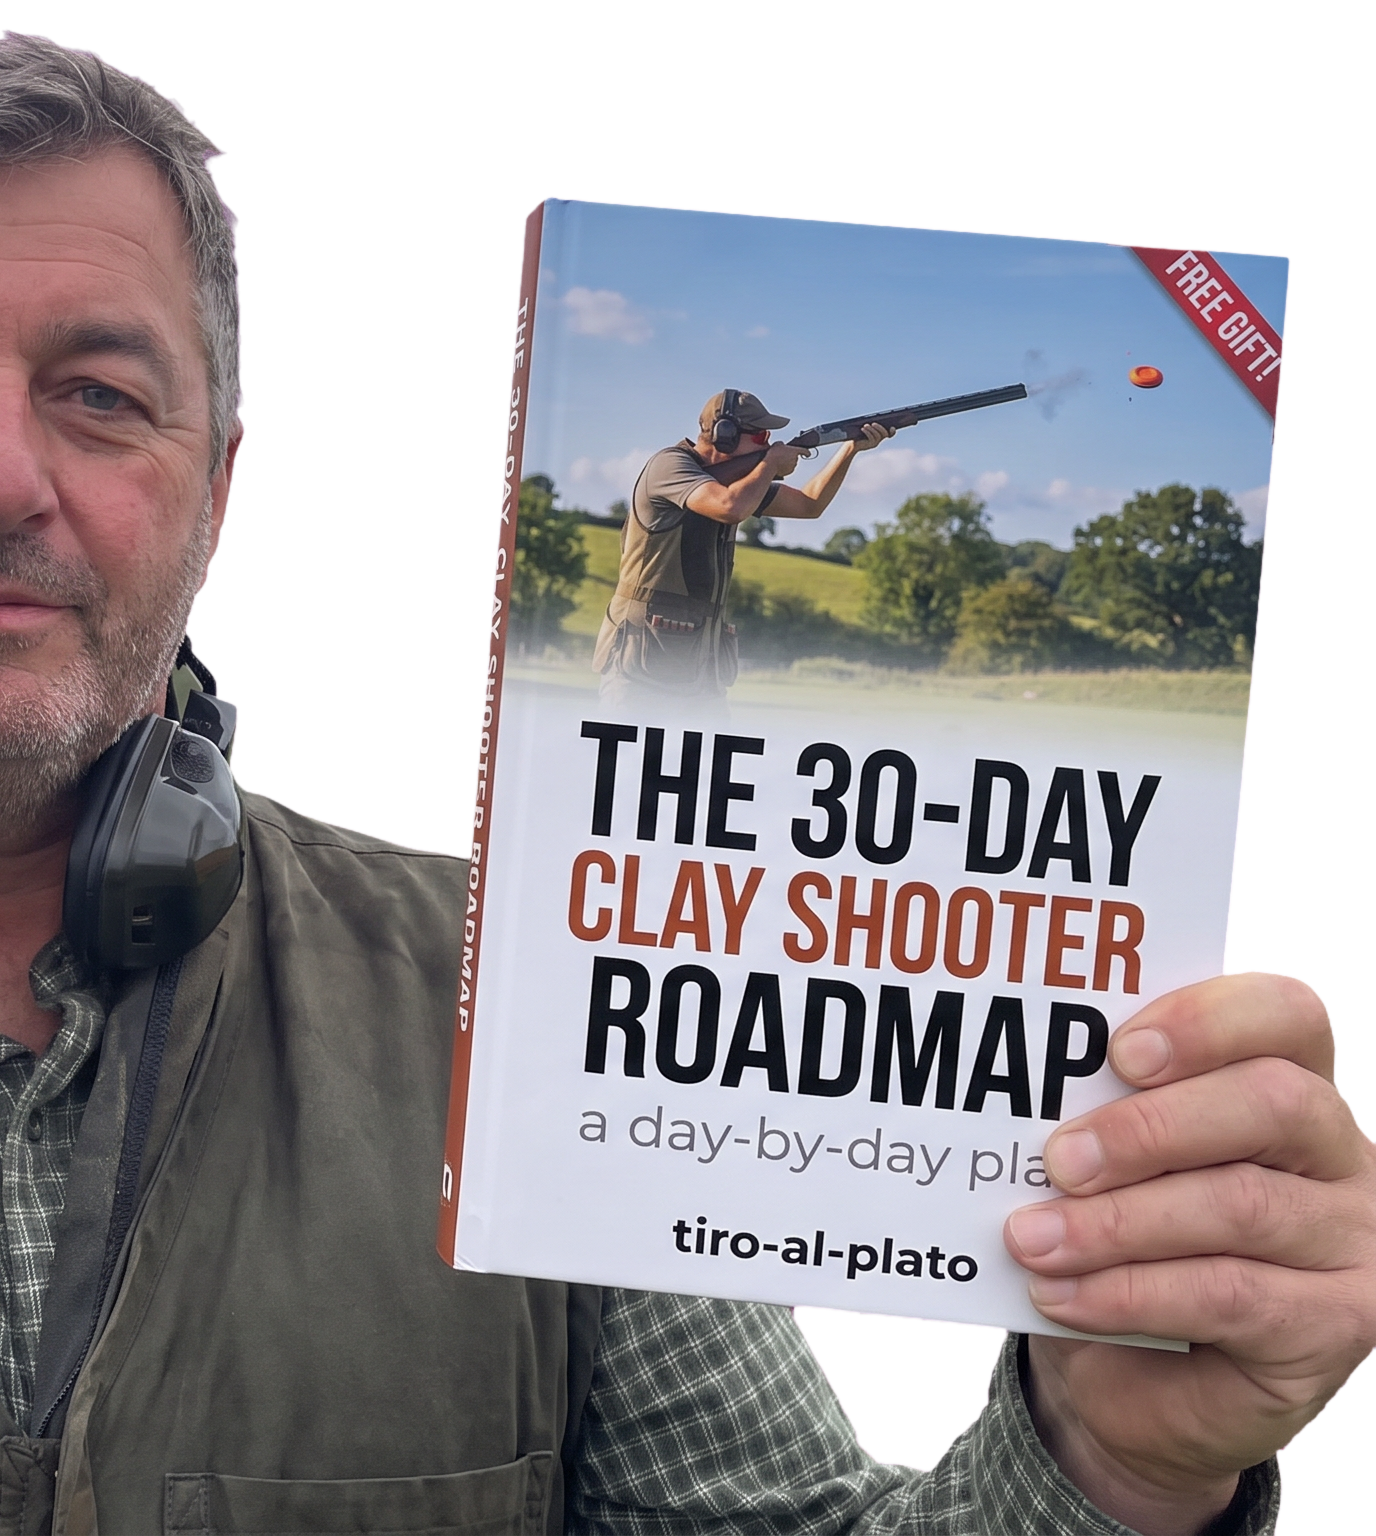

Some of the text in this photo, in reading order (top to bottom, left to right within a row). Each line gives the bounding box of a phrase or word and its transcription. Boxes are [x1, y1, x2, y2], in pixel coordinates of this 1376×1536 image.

[1165, 250, 1283, 383] FREE GIFT!
[459, 297, 528, 1032] THE 30-DAY CLAY SHOOTER ROADMAP
[581, 721, 1161, 886] THE 30-DAY
[568, 849, 1145, 994] CLAY SHOOTER
[585, 956, 1108, 1121] ROADMAP
[580, 1106, 1051, 1191] a day-by-day pla
[673, 1217, 977, 1282] tiro-al-plato
